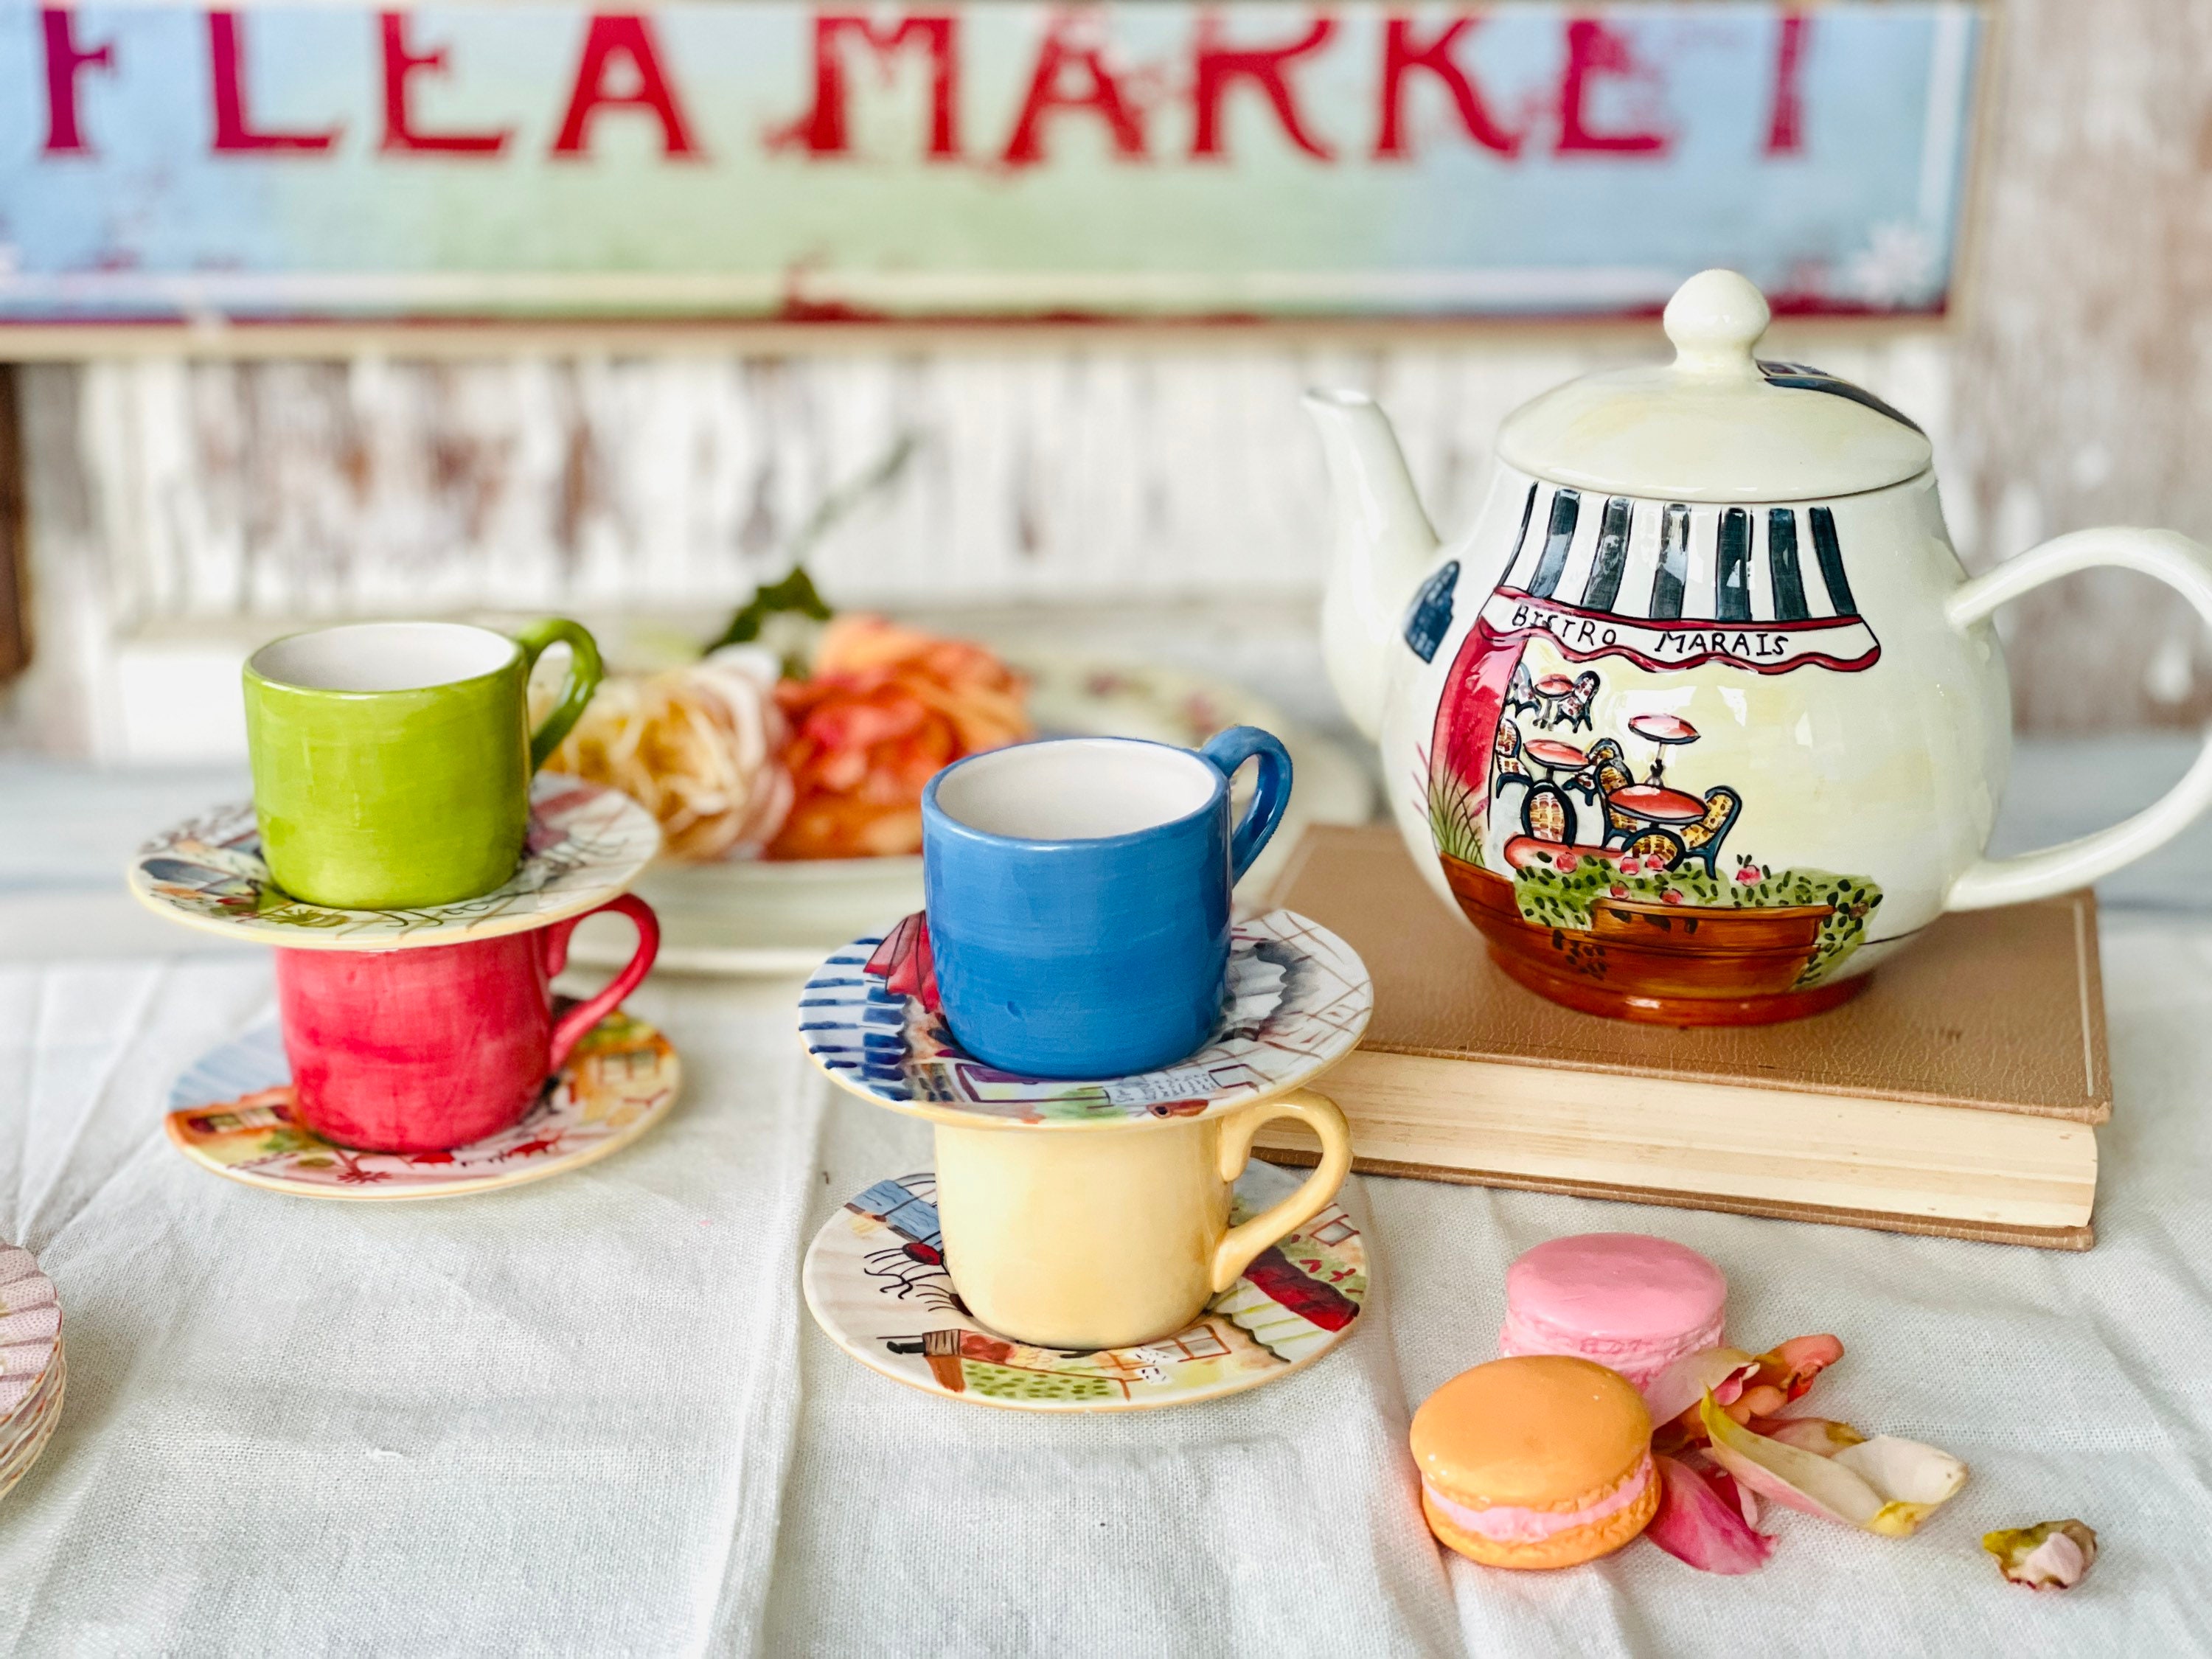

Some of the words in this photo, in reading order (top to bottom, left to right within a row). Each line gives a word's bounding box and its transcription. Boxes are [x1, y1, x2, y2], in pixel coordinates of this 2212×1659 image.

[37, 7, 705, 160] FLEA
[1512, 603, 1616, 647] BISTRO
[1654, 631, 1789, 657] MARAIS
